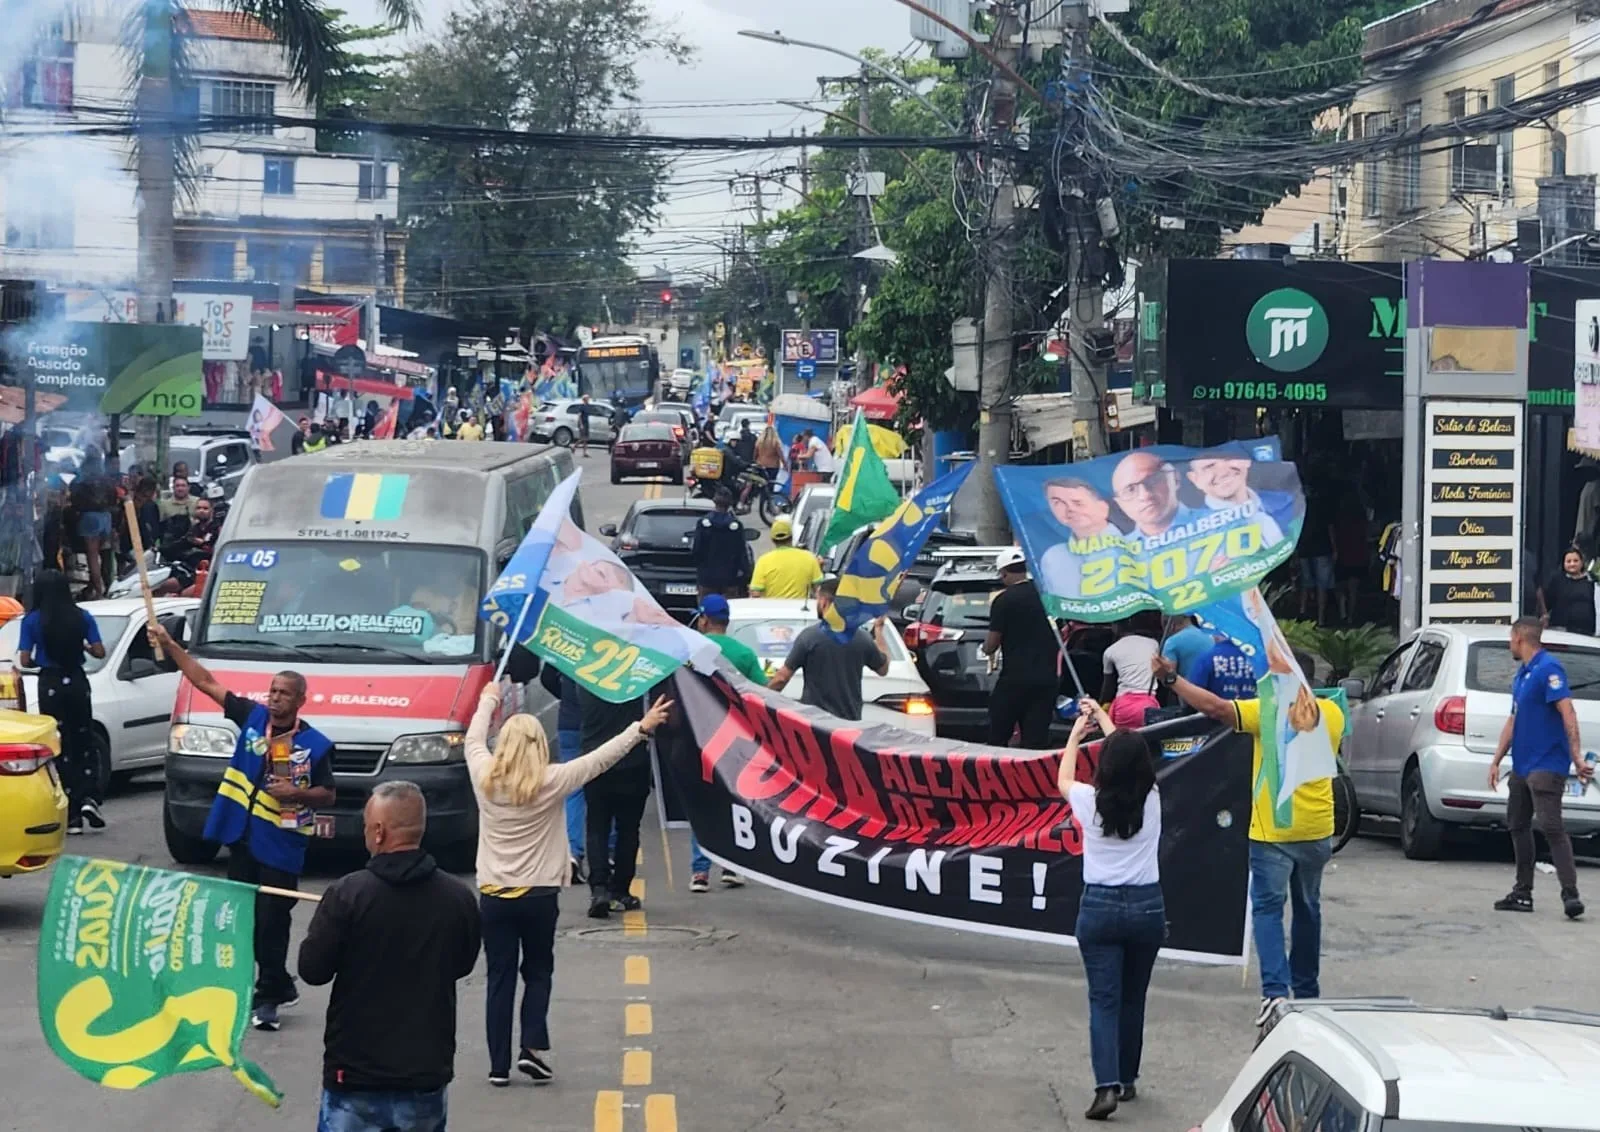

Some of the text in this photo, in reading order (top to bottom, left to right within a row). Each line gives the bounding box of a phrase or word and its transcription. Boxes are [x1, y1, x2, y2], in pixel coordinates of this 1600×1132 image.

[204, 300, 233, 319] TOP
[201, 319, 234, 339] KIDS
[27, 342, 88, 359] Frangão
[28, 356, 81, 371] Assado
[34, 373, 106, 388] ompletão
[153, 392, 195, 409] nio
[1209, 382, 1327, 401] 21 97645-4095
[1435, 418, 1512, 433] Salão de Beleza
[1448, 452, 1498, 466] Barbearia
[1433, 485, 1511, 500] Moda Feminina
[1144, 500, 1256, 550] GUALBERTO
[1458, 518, 1485, 535] Ótica
[252, 549, 276, 567] 05
[1080, 523, 1262, 597] 22070
[1442, 551, 1501, 568] Mega Hair
[1211, 559, 1267, 586] Douglas
[1168, 580, 1208, 610] 22
[350, 614, 422, 634] REALENGO
[575, 639, 640, 691] 22
[331, 694, 410, 708] REALENGO
[702, 676, 888, 838] FORA
[884, 793, 941, 844] DE
[935, 802, 1084, 855] MORAES
